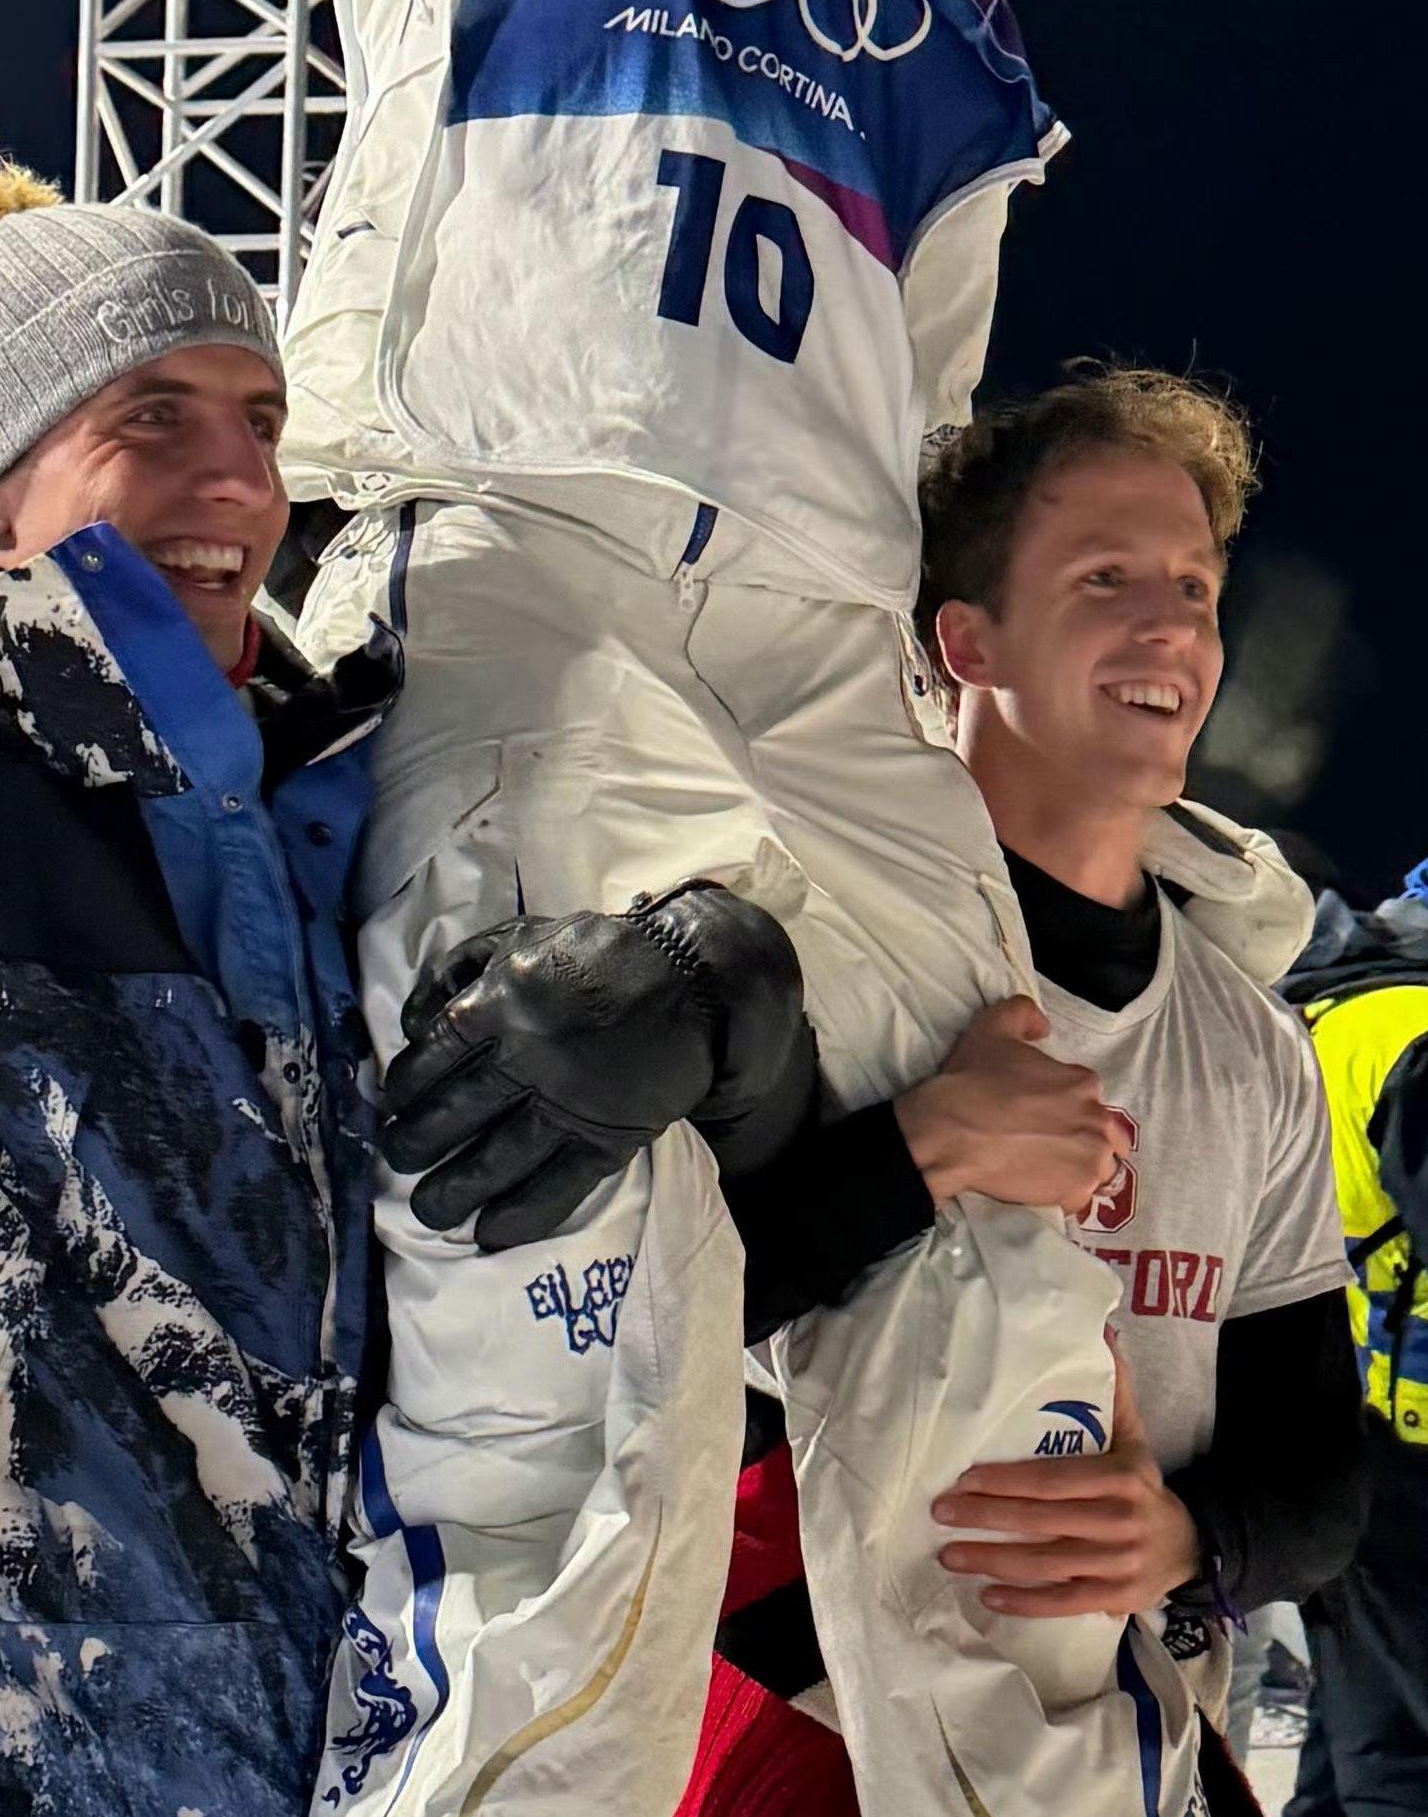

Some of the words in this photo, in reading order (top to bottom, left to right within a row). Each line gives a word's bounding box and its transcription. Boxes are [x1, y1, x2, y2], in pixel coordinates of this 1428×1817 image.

[603, 6, 733, 61] MILANO
[738, 46, 854, 131] CORTINA
[656, 149, 814, 364] 10
[1034, 1429, 1084, 1455] ANTA
